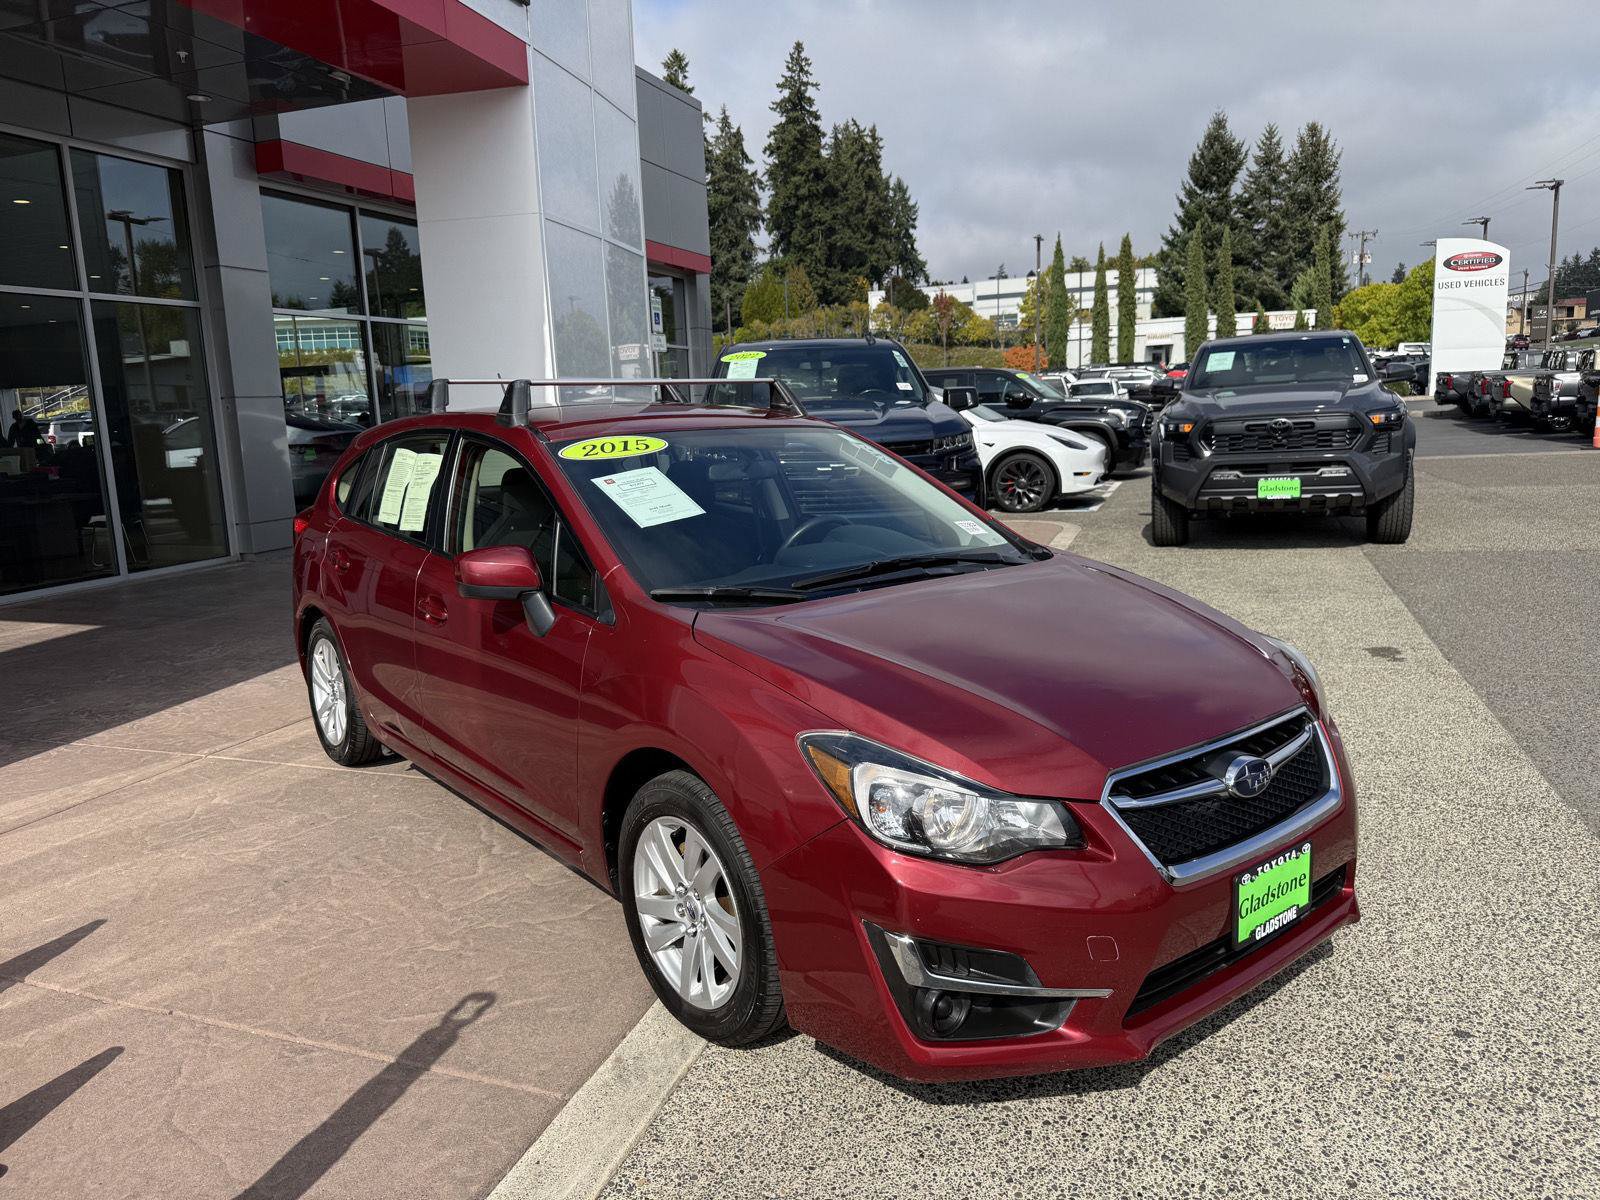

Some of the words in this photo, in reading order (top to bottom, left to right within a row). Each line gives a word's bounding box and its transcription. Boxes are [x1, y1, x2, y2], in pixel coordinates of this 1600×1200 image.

[1450, 257, 1496, 266] CERTIFIED
[1438, 281, 1462, 290] USED
[1463, 278, 1505, 288] VEHICLES
[582, 439, 650, 457] 2015
[1256, 850, 1297, 874] TOYOTA
[1239, 872, 1307, 920] Gladstone
[1255, 905, 1298, 940] GLADSTONE
